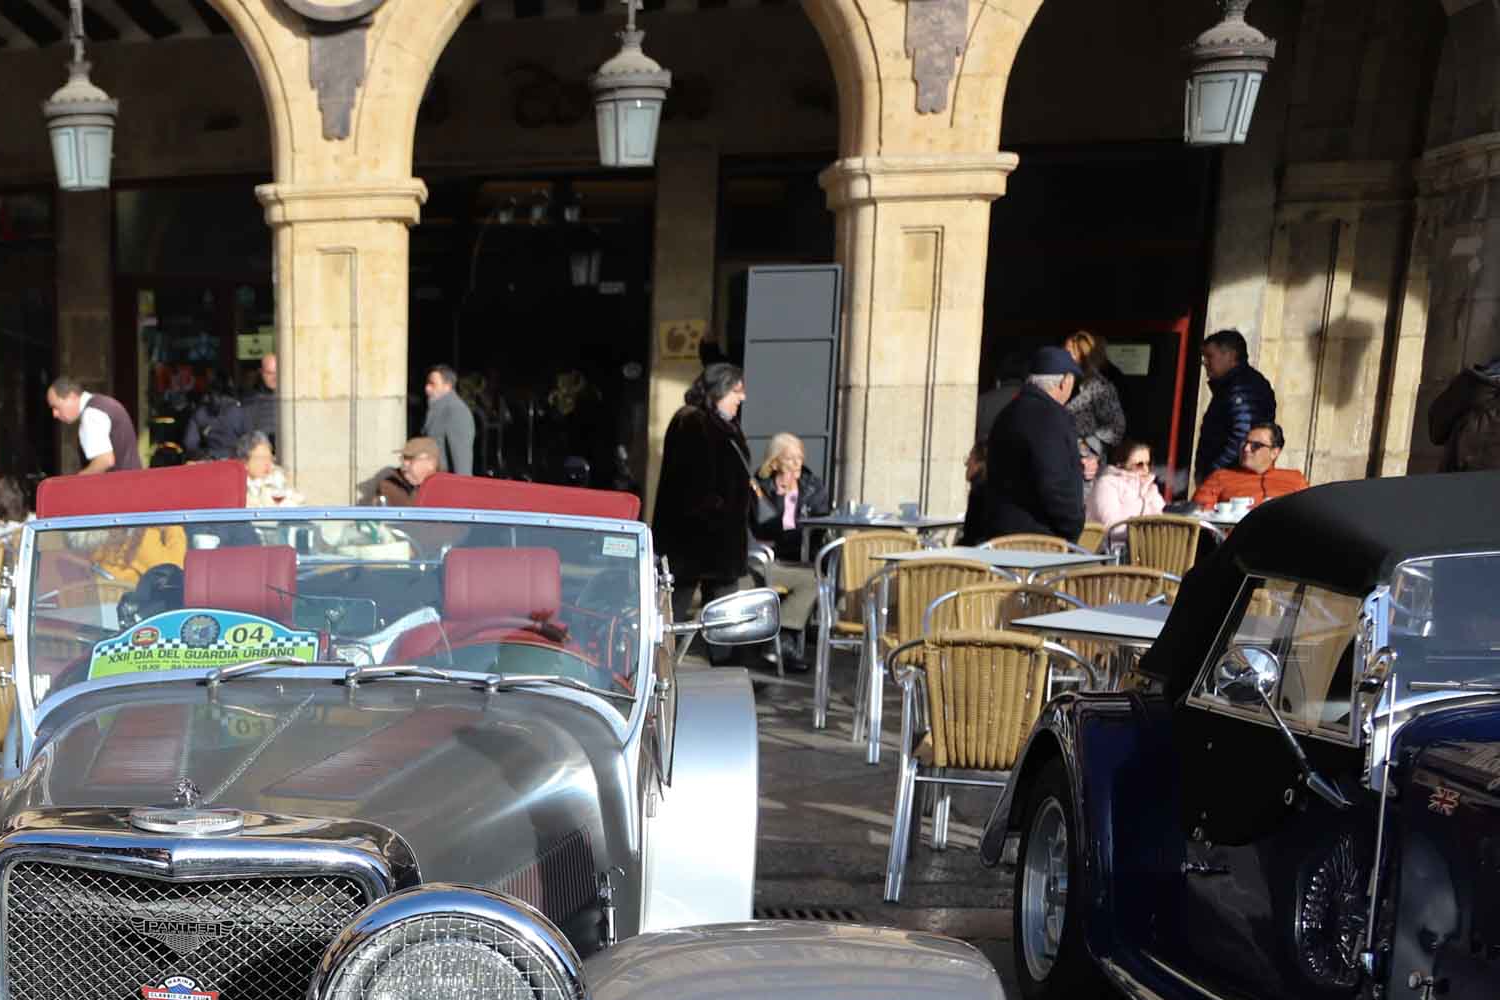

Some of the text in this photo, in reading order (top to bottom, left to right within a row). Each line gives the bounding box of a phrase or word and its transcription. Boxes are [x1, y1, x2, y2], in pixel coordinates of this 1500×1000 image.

[232, 627, 264, 643] 04
[157, 648, 180, 659] DEL
[184, 648, 238, 660] GUARDIA
[243, 647, 295, 658] URBANO
[148, 921, 217, 935] PANTHER
[150, 991, 177, 999] CLASSIC
